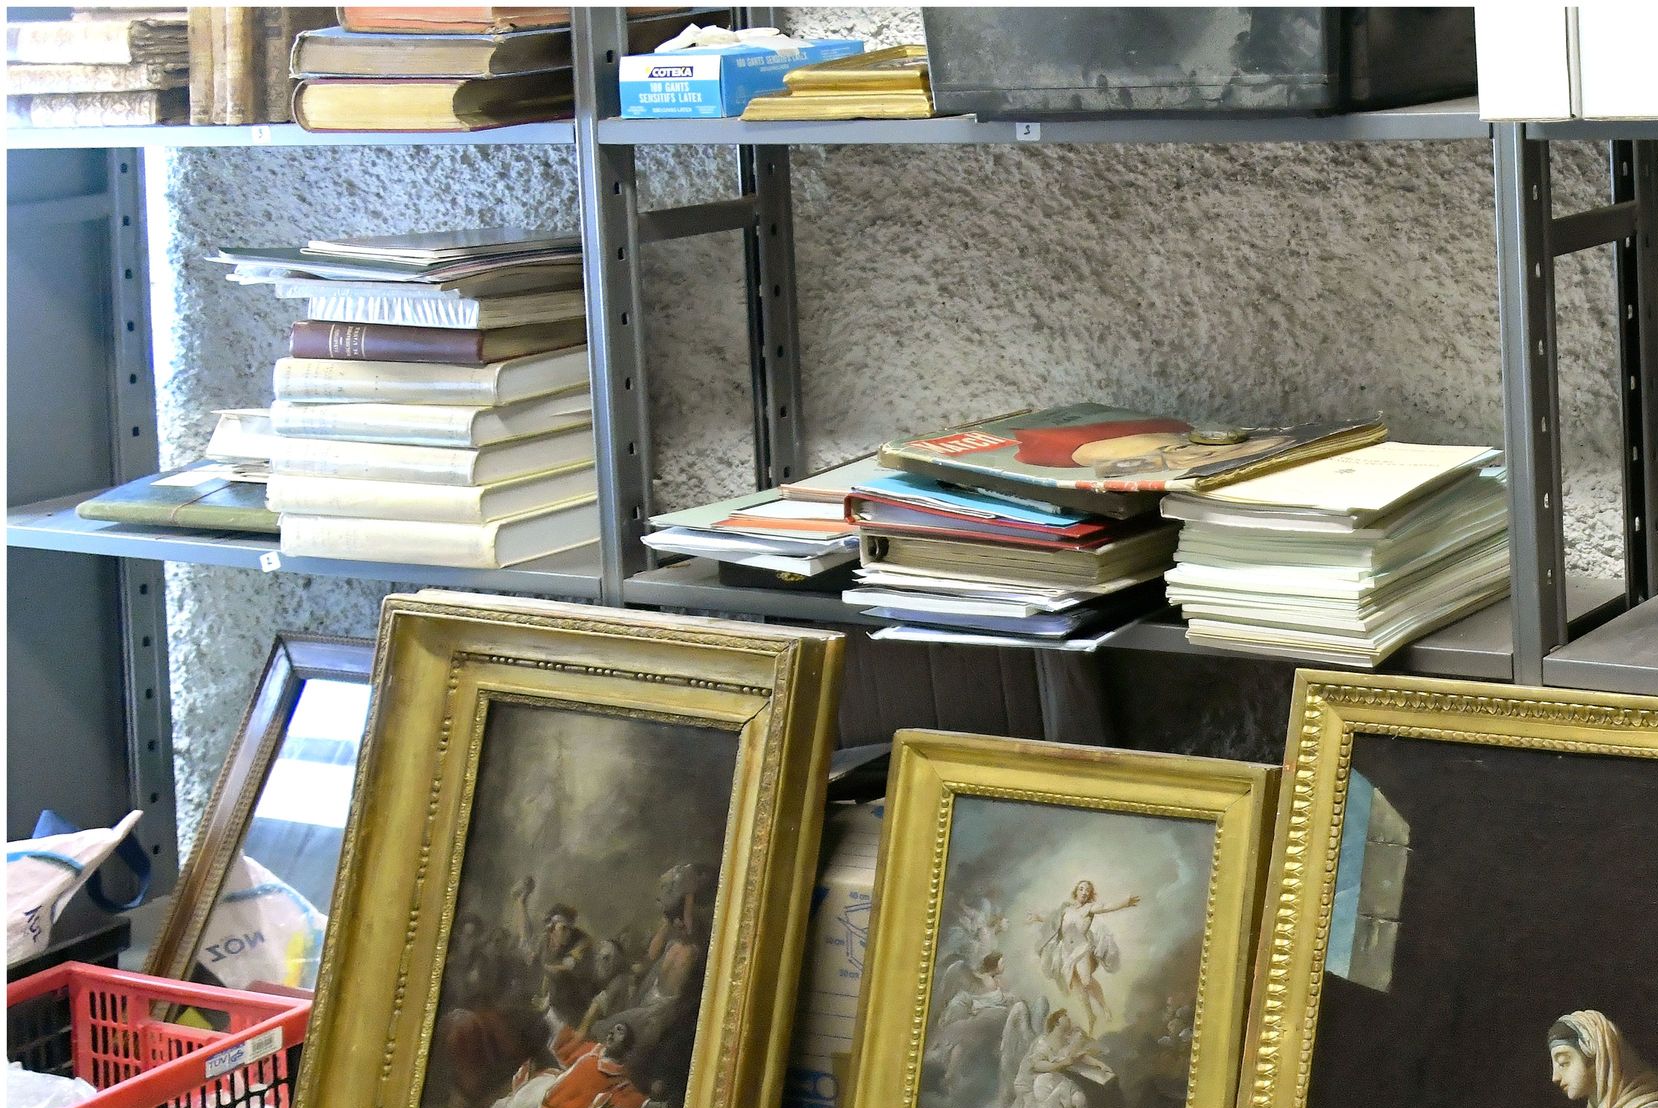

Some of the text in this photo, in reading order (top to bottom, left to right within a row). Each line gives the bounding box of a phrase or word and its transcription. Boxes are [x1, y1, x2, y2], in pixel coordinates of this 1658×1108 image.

[651, 67, 693, 77] COTEKA
[650, 82, 689, 92] 100 GANTS
[639, 93, 702, 103] SENSITIFS LATEX
[908, 431, 1006, 454] MATCH
